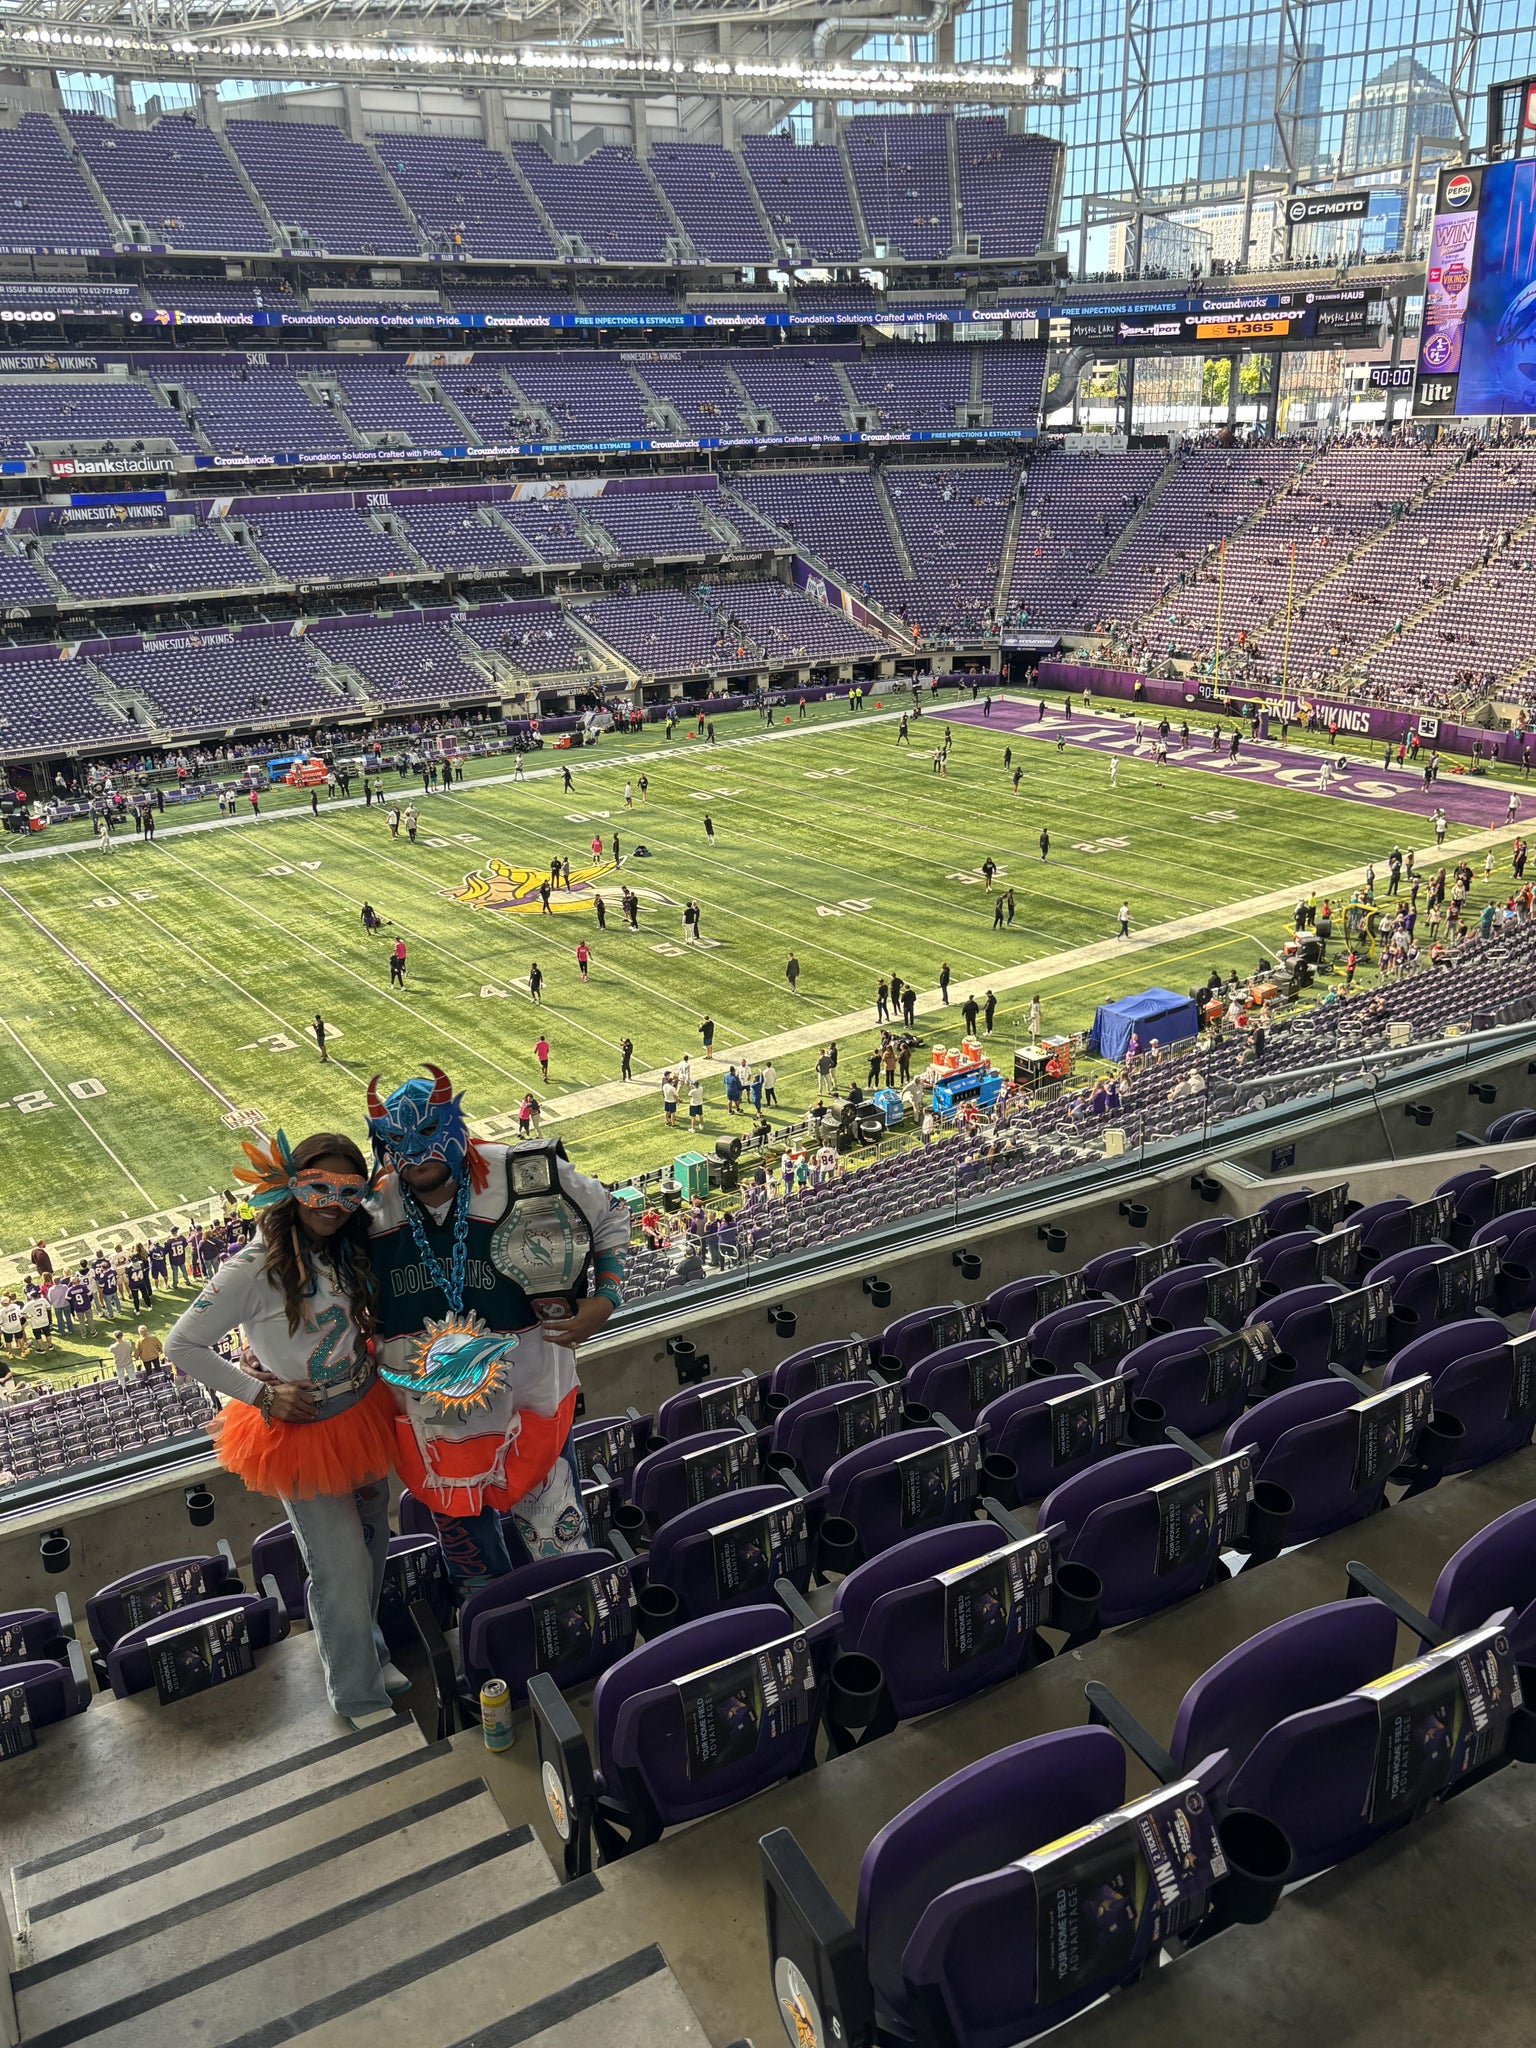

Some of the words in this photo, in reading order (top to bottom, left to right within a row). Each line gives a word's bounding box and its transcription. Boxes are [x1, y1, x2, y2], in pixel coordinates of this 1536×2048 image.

[1448, 187, 1471, 196] PEPSI
[1308, 201, 1363, 215] CFMOTO
[1435, 222, 1474, 248] WIN
[1315, 293, 1340, 301] TRAINING
[1341, 291, 1365, 300] HAUS
[1061, 308, 1084, 316] FREE
[1135, 303, 1177, 313] ESTIMATES
[1203, 297, 1268, 311] Groundworks
[0, 311, 56, 322] 90:00
[130, 312, 143, 322] 0
[178, 311, 253, 325] Groundworks
[282, 314, 336, 324] Foundation
[337, 315, 379, 325] Solutions
[381, 315, 414, 325] Crafted
[416, 315, 435, 325] with
[437, 315, 461, 325] Pride.
[485, 315, 550, 326] Groundworks
[705, 315, 766, 325] Groundworks
[789, 314, 835, 323] Foundation
[836, 314, 873, 323] Solutions
[875, 313, 905, 322] Crafted
[906, 312, 925, 322] with
[927, 312, 950, 321] Pride.
[972, 309, 1037, 320] Groundworks
[1185, 314, 1239, 325] CURRENT
[1242, 311, 1305, 323] JACKPOT
[1318, 312, 1344, 325] Mystic
[1073, 325, 1097, 337] Mystic
[1227, 323, 1273, 335] 5,365
[58, 357, 98, 369] VIKINGS
[246, 354, 270, 365] SKOL
[620, 352, 653, 362] MINNESOTA
[660, 351, 682, 361] VIKINGS
[1372, 370, 1409, 386] 90:00
[1419, 385, 1453, 407] Lite
[718, 437, 753, 446] Foundation
[754, 436, 782, 445] Solutions
[784, 436, 807, 444] Crafted
[808, 435, 822, 443] with
[823, 434, 841, 443] Pride.
[860, 432, 911, 441] Groundworks
[931, 431, 946, 439] FREE
[988, 430, 1022, 438] ESTIMATES
[542, 444, 559, 452] FREE
[599, 442, 631, 450] ESTIMATES
[650, 439, 700, 449] Groundworks
[299, 452, 341, 462] Foundation
[342, 450, 377, 461] Solutions
[378, 450, 405, 459] Crafted
[406, 449, 422, 458] with
[423, 448, 444, 457] Pride.
[467, 446, 520, 456] Groundworks
[213, 456, 275, 466] Groundworks
[366, 494, 391, 507] SKOL
[64, 506, 117, 521] MINNESOTA
[127, 505, 163, 518] VIKINGS
[458, 573, 473, 581] LAND
[343, 581, 377, 589] ORTHOPEDICS
[143, 638, 191, 651] MINNESOTA
[201, 633, 235, 647] VIKINGS
[1315, 704, 1371, 733] VIKINGS
[1421, 719, 1435, 734] 25
[171, 1244, 184, 1257] 18
[76, 1294, 83, 1305] 9
[8, 1313, 17, 1323] 18
[36, 1308, 42, 1317] 3
[218, 1343, 229, 1355] 18
[305, 1303, 353, 1385] 2
[1217, 1492, 1228, 1514] WIN
[1013, 1578, 1025, 1602] WIN
[596, 1598, 610, 1619] WIN
[763, 1680, 779, 1707] WIN
[1469, 1694, 1488, 1732] WIN
[1394, 1716, 1402, 1743] FIELD
[1393, 1744, 1402, 1773] HOME
[1400, 1714, 1412, 1793] ADVANTAGE
[1391, 1774, 1400, 1800] YOUR
[1141, 1820, 1158, 1853] TICKETS
[1154, 1861, 1180, 1906] WIN
[1057, 1889, 1066, 1917] FIELD
[1058, 1917, 1068, 1949] HOME
[1070, 1886, 1079, 1972] ADVANTAGE
[1058, 1950, 1069, 1979] YOUR
